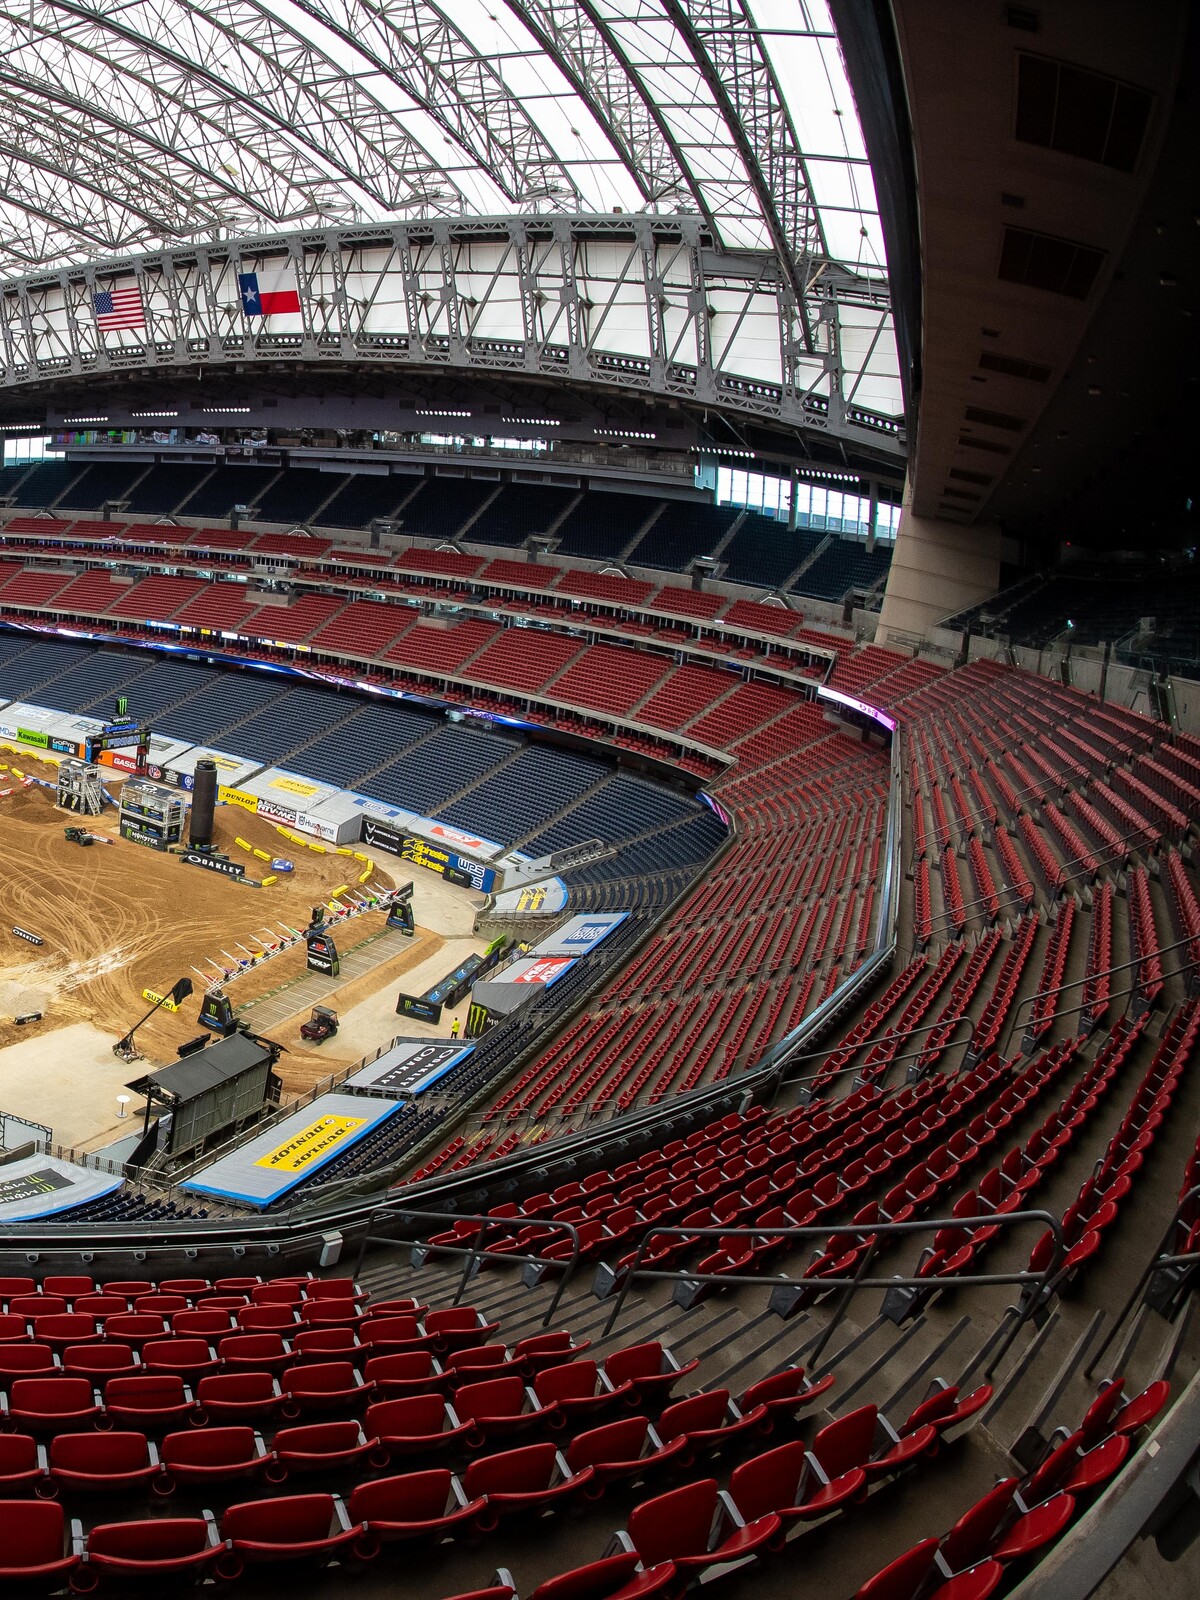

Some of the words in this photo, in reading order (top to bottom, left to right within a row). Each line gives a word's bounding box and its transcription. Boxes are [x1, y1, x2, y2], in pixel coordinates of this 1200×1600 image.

[18, 731, 47, 745] Kawasaki
[52, 738, 75, 749] GoPro
[114, 757, 136, 770] GASG
[226, 793, 256, 805] DUNLOP
[305, 818, 334, 835] Husvarna
[414, 842, 449, 862] alpinestars
[202, 858, 242, 874] OAKLEY
[413, 854, 444, 873] alpinestar
[458, 857, 486, 878] WPS
[380, 1056, 422, 1084] OAKLEY
[400, 1058, 441, 1086] OAKLEY
[270, 1124, 325, 1164] DUNLOP
[292, 1128, 346, 1168] DUNLOP
